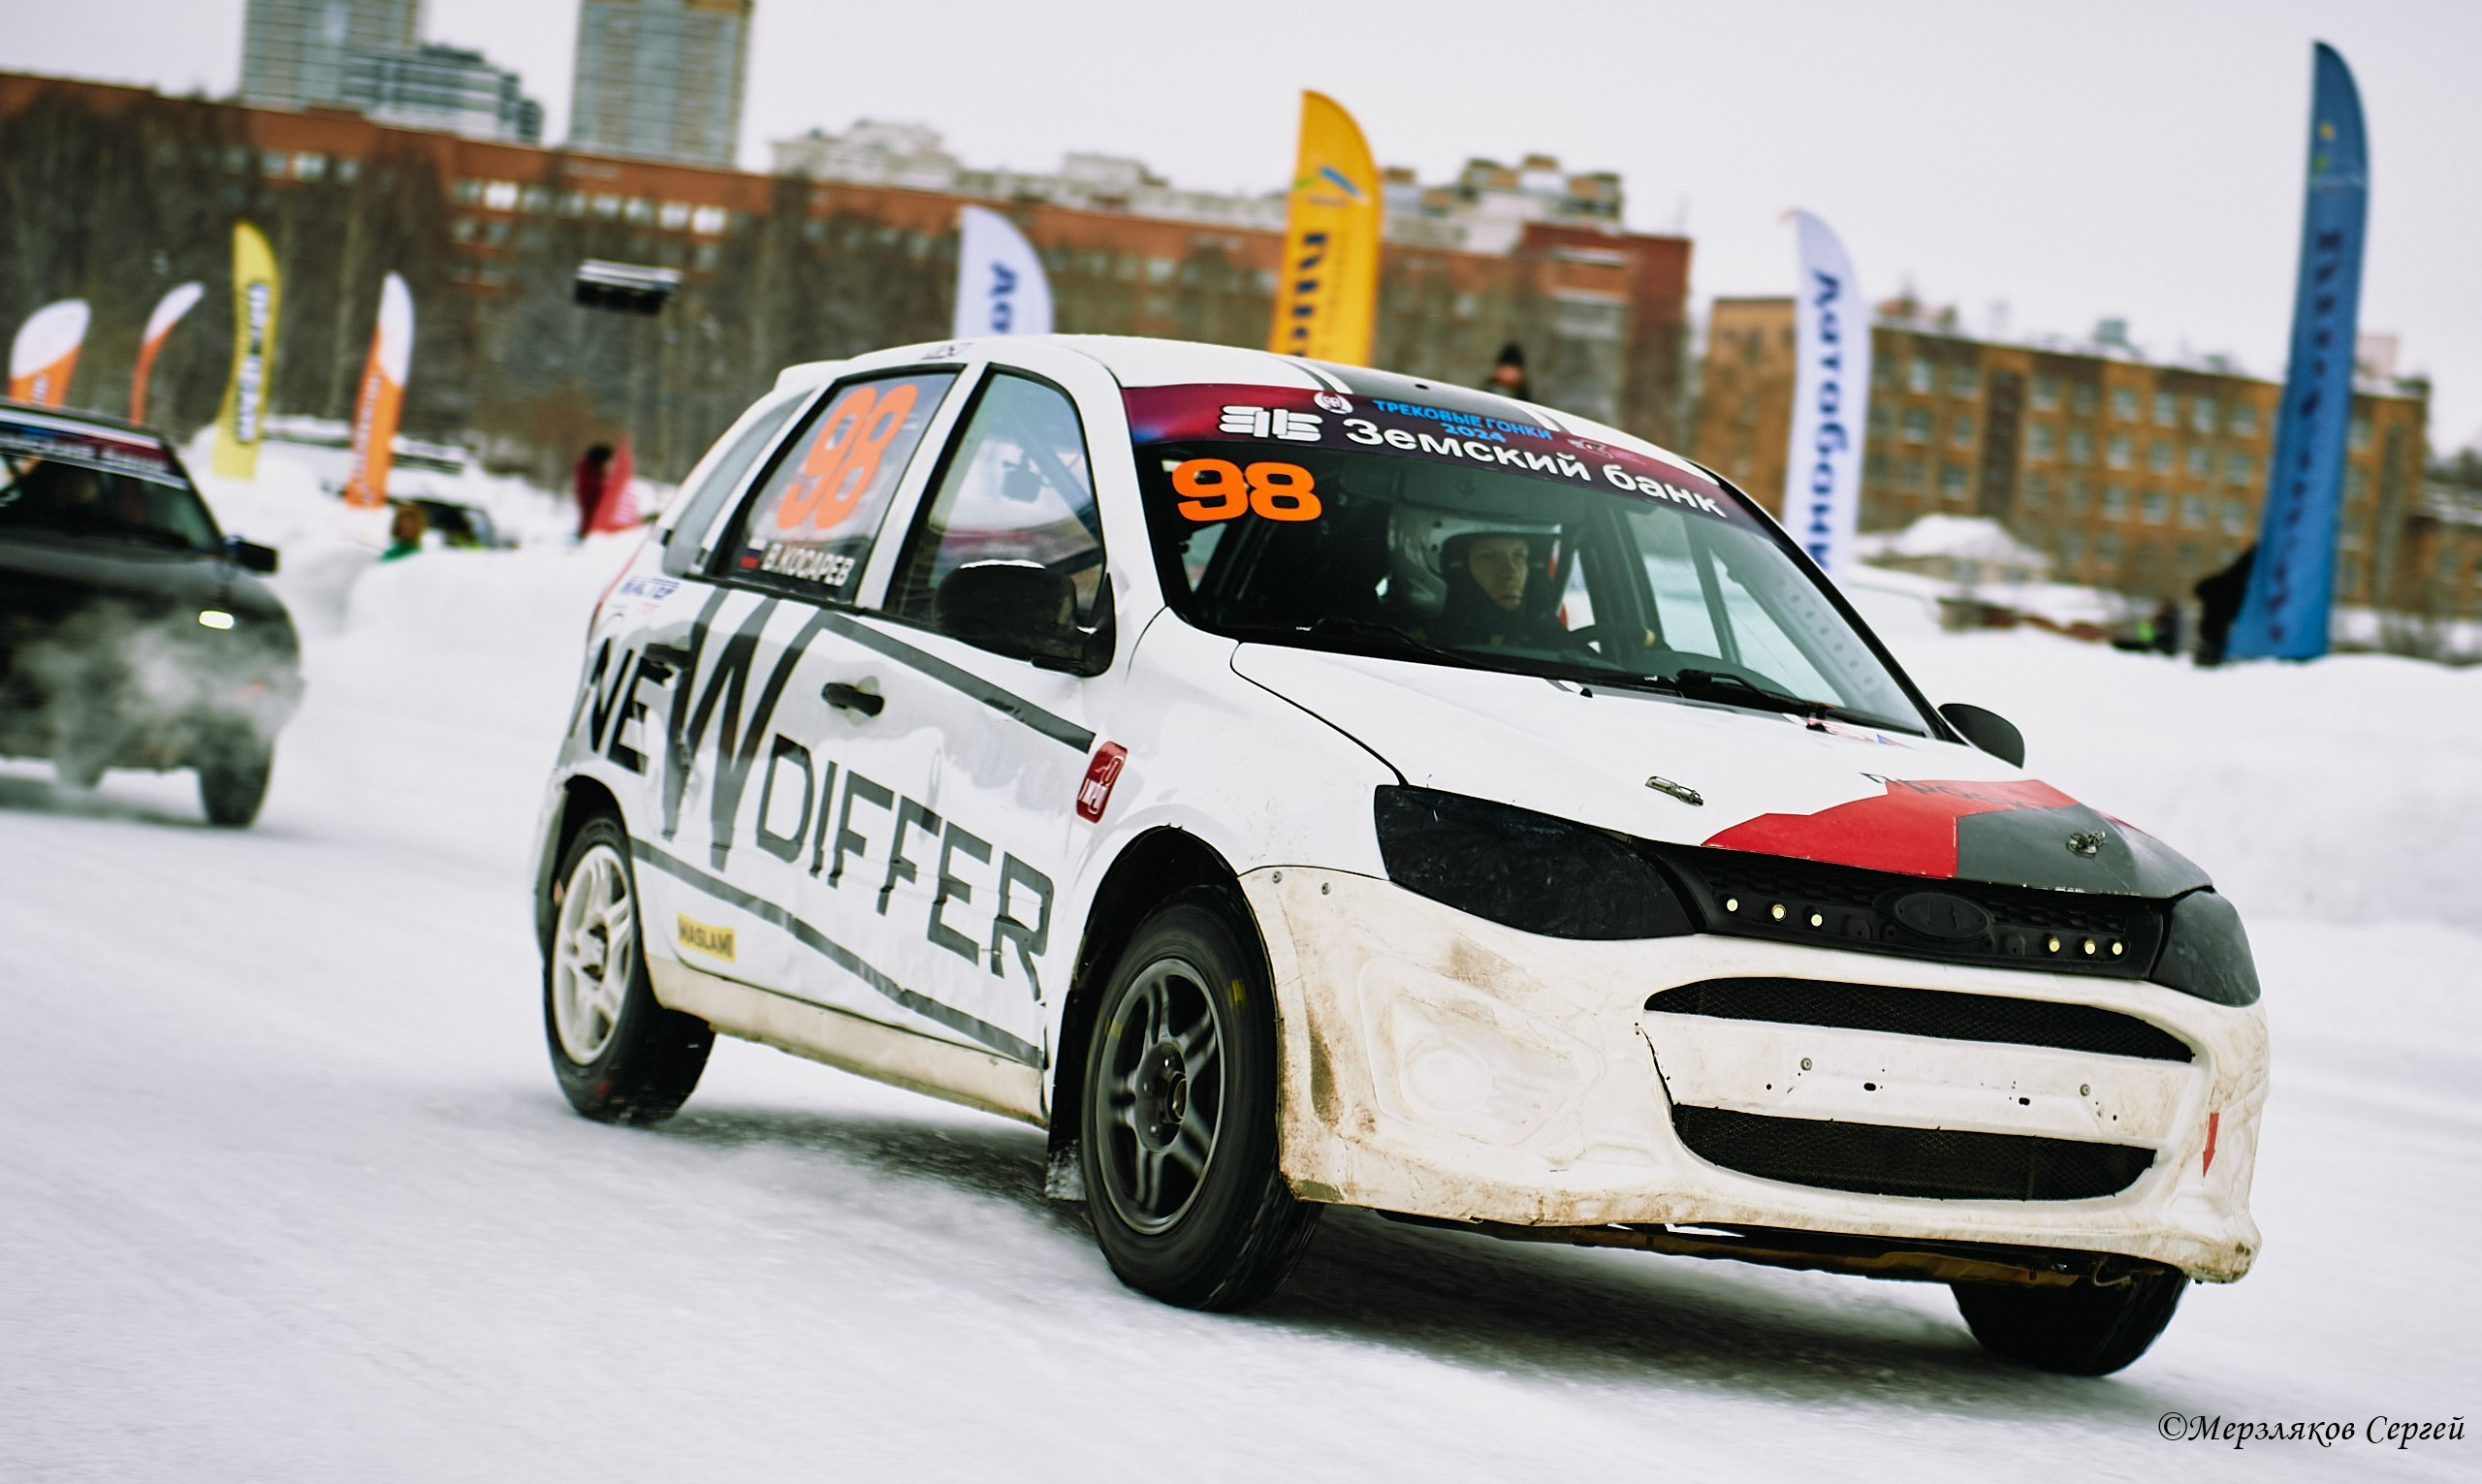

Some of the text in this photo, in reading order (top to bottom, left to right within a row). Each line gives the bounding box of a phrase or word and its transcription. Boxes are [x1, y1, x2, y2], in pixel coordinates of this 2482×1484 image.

[777, 383, 920, 530] 98
[1371, 398, 1553, 442] ТРЕКОВЫЕ ГОНКИ
[1440, 422, 1507, 444] 2024
[1170, 458, 1322, 522] 98
[1342, 418, 1728, 519] Земский банк
[590, 586, 1054, 1002] NEW DIFFER
